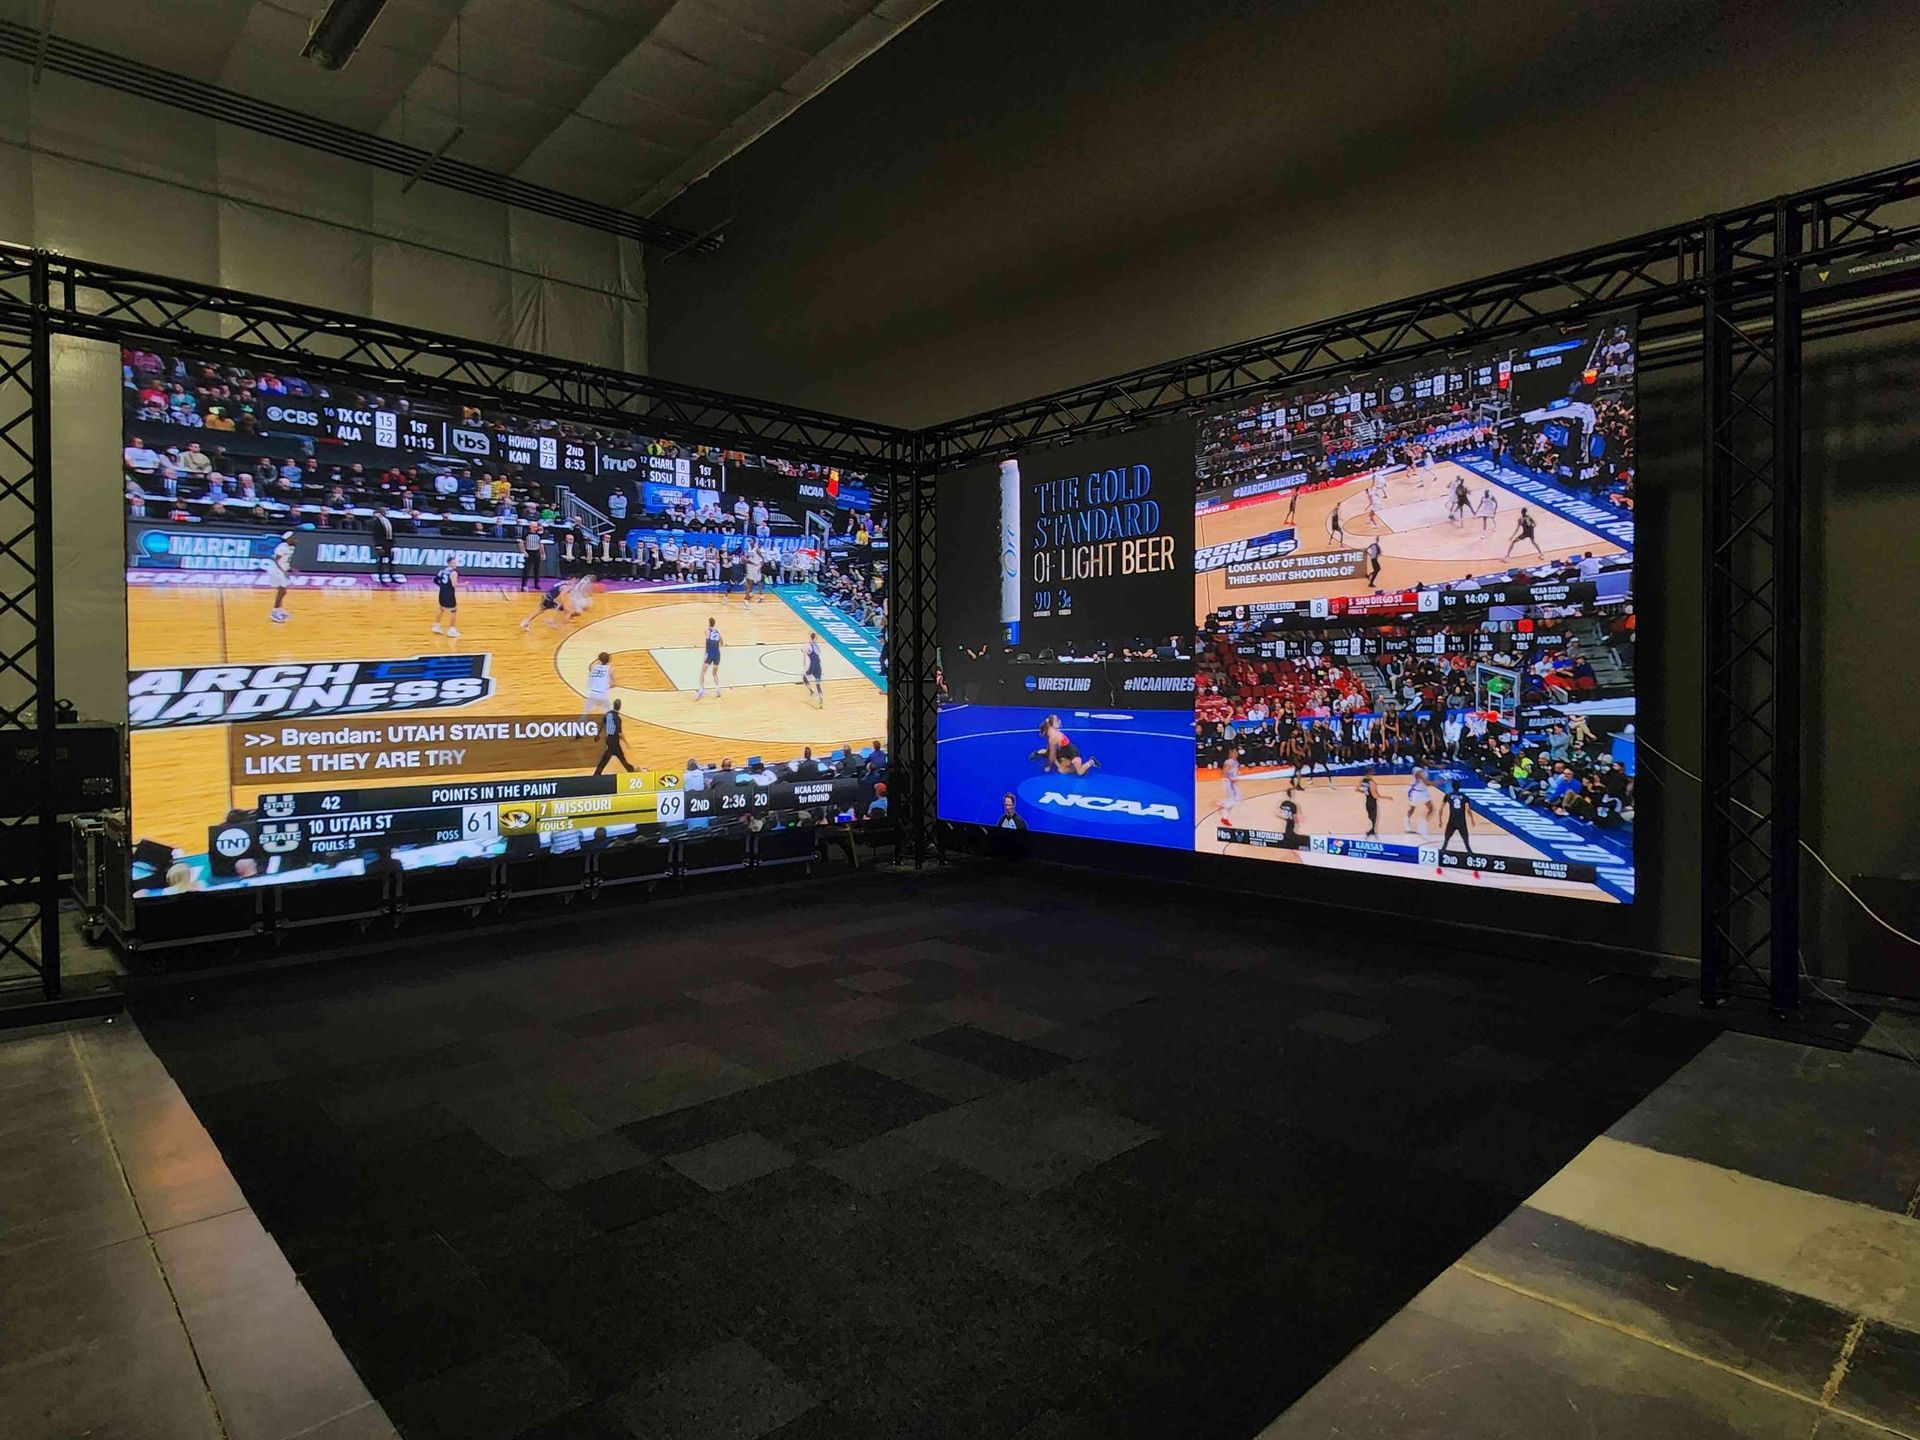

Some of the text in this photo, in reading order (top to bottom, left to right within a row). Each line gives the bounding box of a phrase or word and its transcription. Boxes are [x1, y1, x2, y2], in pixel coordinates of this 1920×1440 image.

[283, 409, 318, 426] CBS
[324, 408, 334, 417] 16
[380, 415, 392, 426] 15
[410, 420, 427, 433] 1ST
[327, 425, 435, 449] 1 ALA 22 11:15
[457, 434, 487, 450] tbs
[497, 434, 506, 443] 16
[508, 436, 538, 450] HOWRD
[566, 444, 584, 457] 2ND
[509, 450, 531, 464] KAN
[565, 458, 586, 471] 8:53
[650, 457, 674, 470] CHARL
[650, 470, 672, 484] SDSU
[1233, 473, 1307, 497] #MARCHMADNESS
[799, 485, 824, 497] NCAA
[1033, 464, 1151, 514] THE GOLD
[1033, 500, 1160, 549] STANDARD
[168, 536, 250, 557] MARCH
[1033, 536, 1175, 583] OF LIGHT BEER
[1228, 552, 1363, 573] LOOK A LOT OF TIMES OF THE
[1228, 566, 1354, 585] THREE-POINT SHOOTING OF
[1034, 591, 1051, 610] 90
[1256, 603, 1295, 611] CHARLESTON
[1316, 602, 1322, 613] 8
[1355, 597, 1371, 605] SAN
[1371, 595, 1393, 605] DIEGO
[1394, 595, 1403, 603] ST
[1425, 595, 1432, 607] 6
[1444, 596, 1457, 606] 1ST
[1465, 593, 1490, 604] 14:09
[1494, 593, 1506, 603] 18
[1537, 636, 1562, 644] NCAA
[1038, 677, 1092, 692] WRESTLING
[1123, 677, 1195, 692] #NCAAWRES
[282, 727, 381, 746] Brendan:
[388, 725, 445, 743] UTAH
[450, 724, 510, 741] STATE
[515, 721, 598, 739] LOOKING
[245, 749, 466, 775] LIKE THEY ARE TRY
[321, 777, 643, 810] 42 POINTS IN THE PAINT 26
[794, 784, 832, 795] NCAA SOUTH
[808, 793, 829, 803] ROUND
[263, 801, 296, 811] STATE
[309, 794, 767, 834] 10 UTAH ST 61 7 MISSOURI 69 2ND 2:36 20
[1039, 791, 1180, 820] NCAA
[216, 838, 250, 849] TNT
[259, 831, 301, 843] STATE
[436, 831, 459, 841] POSS
[1256, 831, 1284, 840] HOWARD
[1313, 839, 1325, 850] 54
[1355, 841, 1383, 851] KANSAS
[1421, 850, 1435, 862] 73
[1467, 856, 1487, 868] 8:59
[1494, 860, 1506, 870] 25
